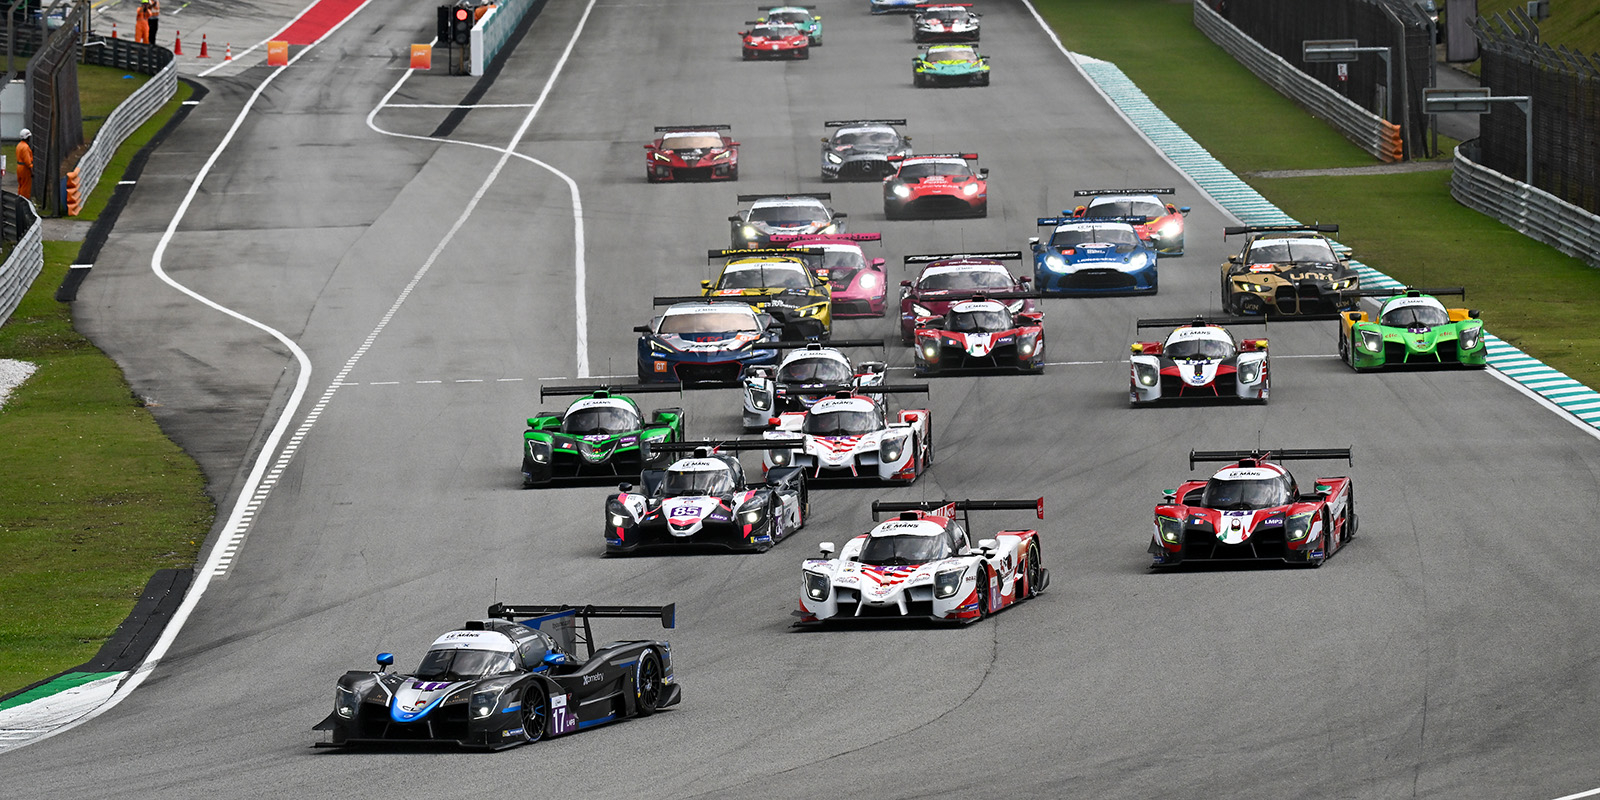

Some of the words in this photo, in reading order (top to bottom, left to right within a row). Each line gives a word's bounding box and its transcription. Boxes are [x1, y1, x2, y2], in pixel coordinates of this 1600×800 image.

[656, 362, 665, 371] GT
[673, 507, 699, 517] 85
[553, 708, 566, 734] 17
